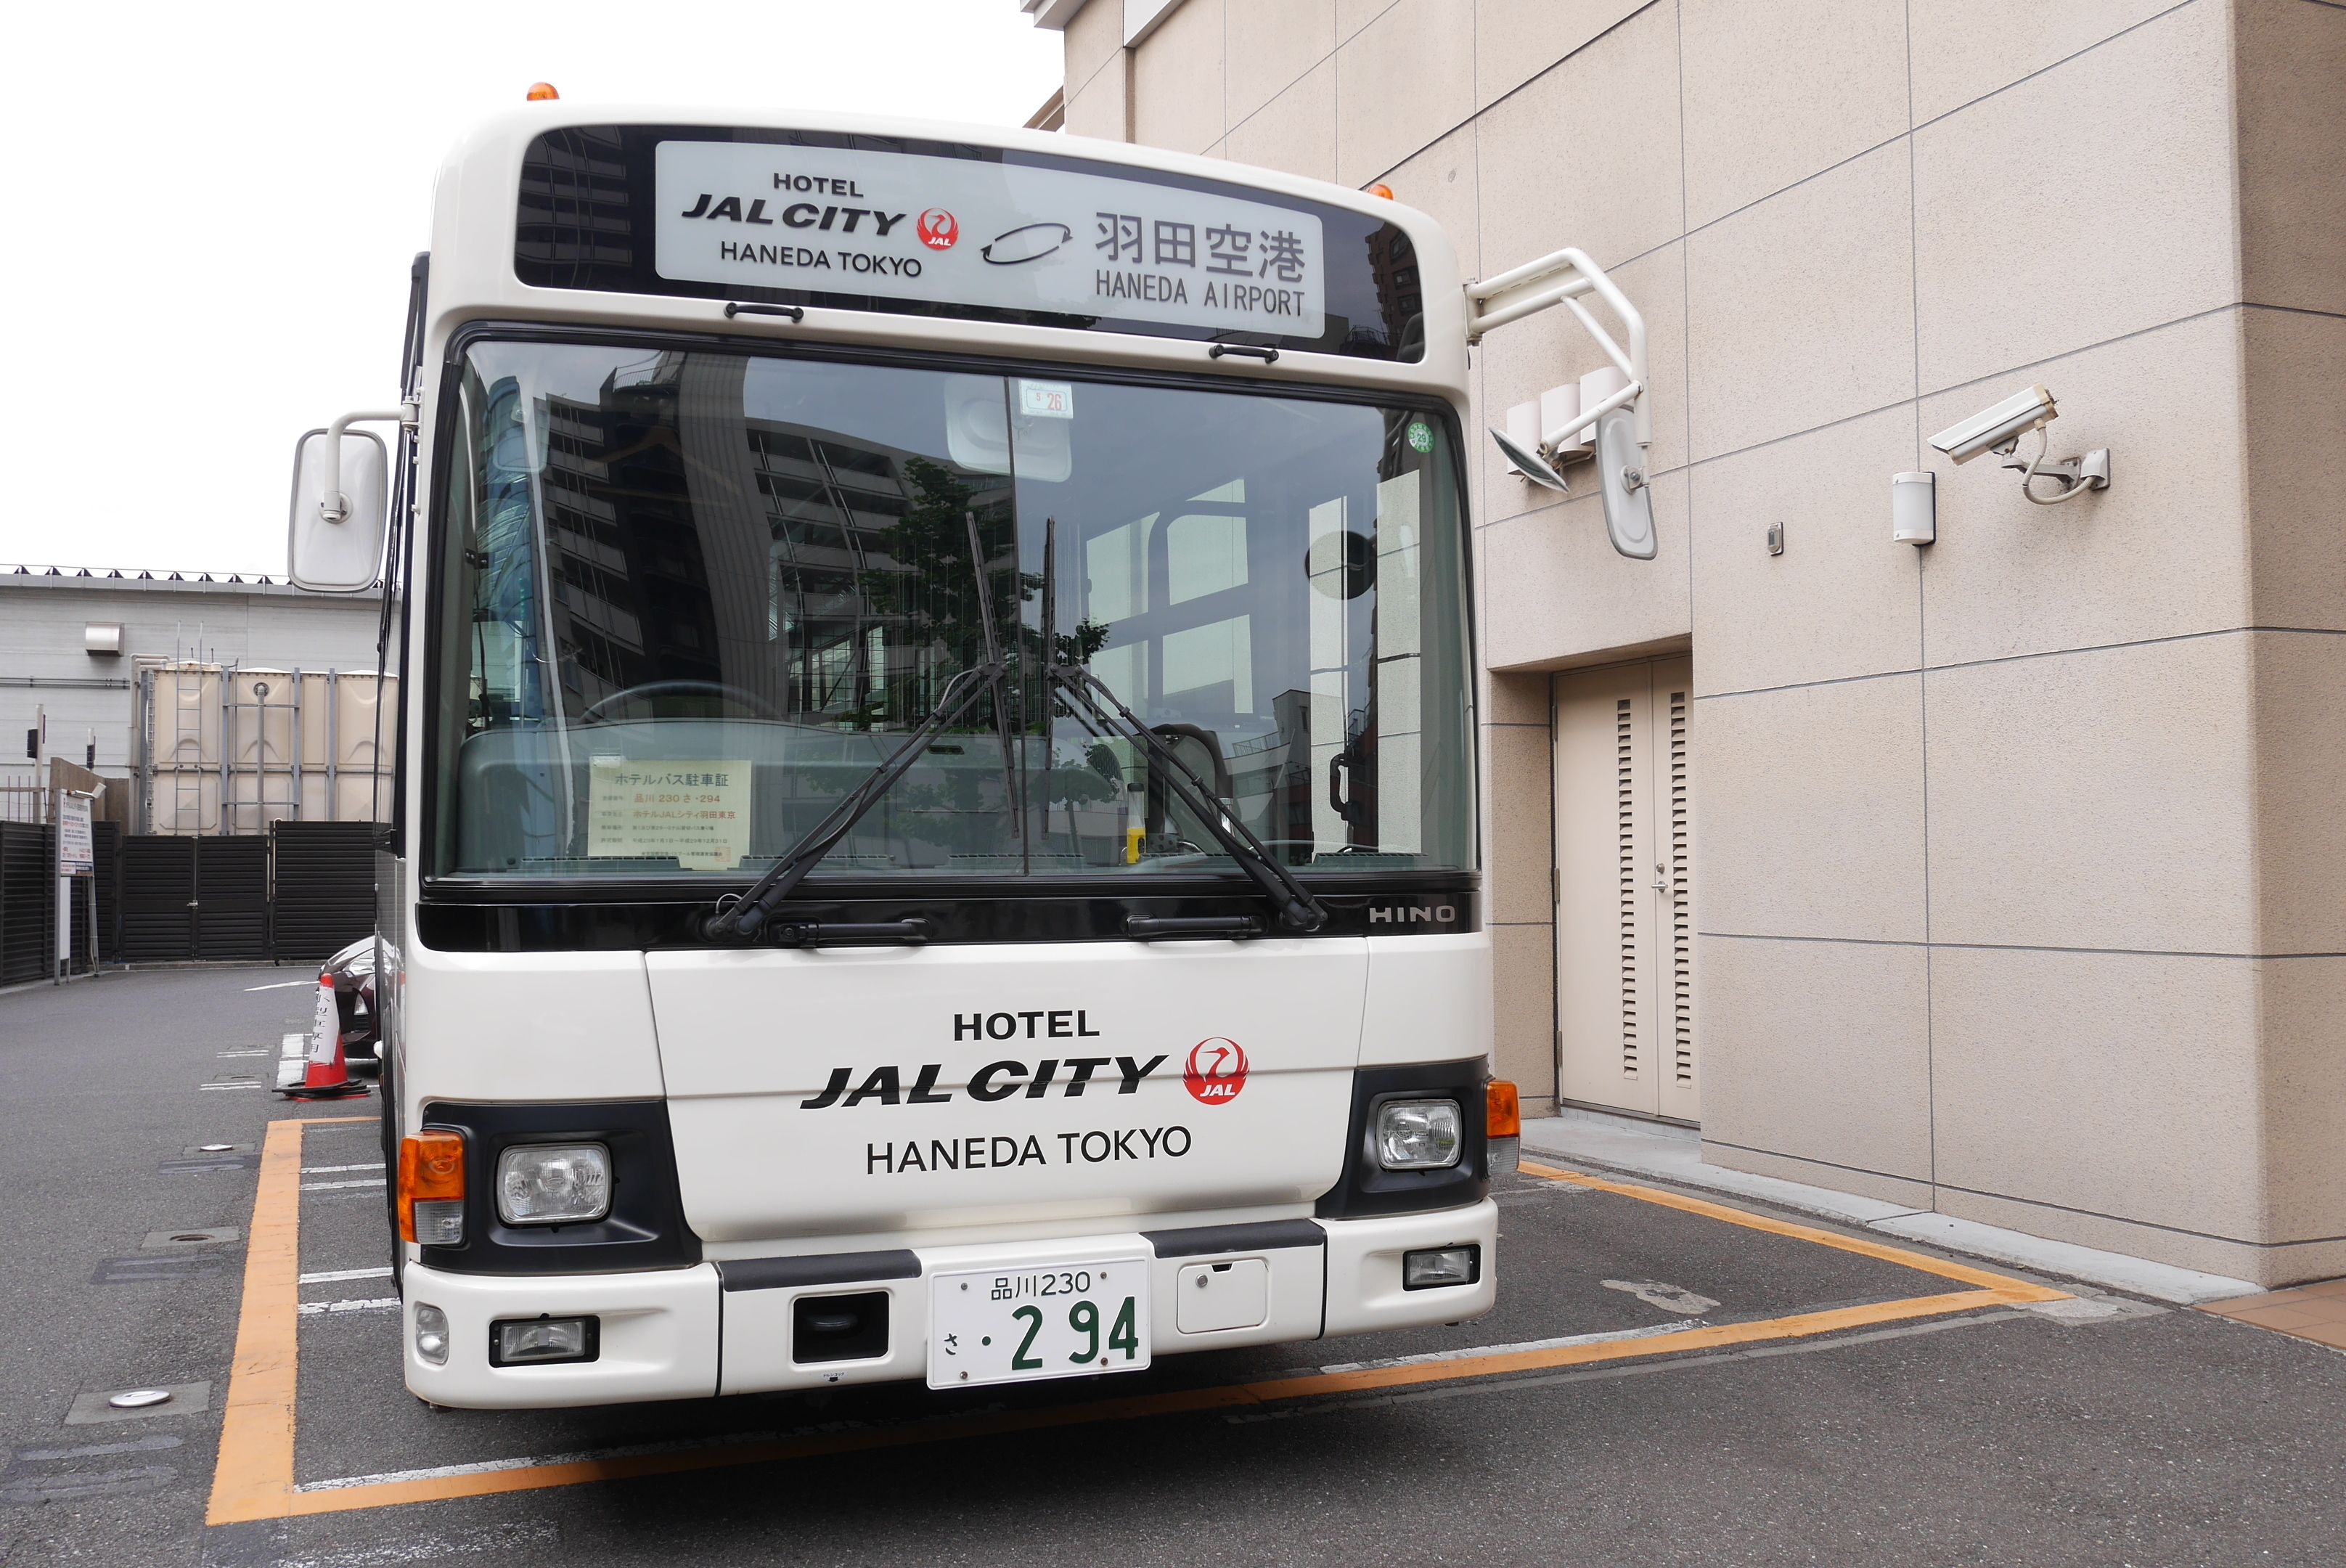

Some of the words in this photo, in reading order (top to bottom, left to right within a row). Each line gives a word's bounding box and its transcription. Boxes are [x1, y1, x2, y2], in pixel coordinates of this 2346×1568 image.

[773, 172, 865, 198] HOTEL
[681, 193, 774, 225] JAL
[782, 203, 907, 237] CITY
[928, 237, 952, 246] JAL
[1095, 211, 1307, 284] 羽田空港
[721, 240, 832, 270] HANEDA
[837, 251, 922, 278] TOKYO
[1096, 269, 1188, 304] HANEDA
[1203, 281, 1305, 317] AIRPORT
[1047, 392, 1063, 411] 26
[615, 773, 729, 787] ホテルバス駐車証
[634, 793, 654, 803] 品川
[658, 794, 679, 803] 230
[633, 810, 737, 820] ホテルJALシティ羽田東京
[1370, 906, 1455, 923] HINO
[954, 1010, 1100, 1042] HOTEL
[799, 1063, 952, 1109] JAL
[966, 1054, 1169, 1102] CITY
[1200, 1085, 1235, 1097] JAL
[867, 1135, 1047, 1175] HANEDA
[1057, 1125, 1191, 1164] TOKYO
[944, 1333, 957, 1355] さ
